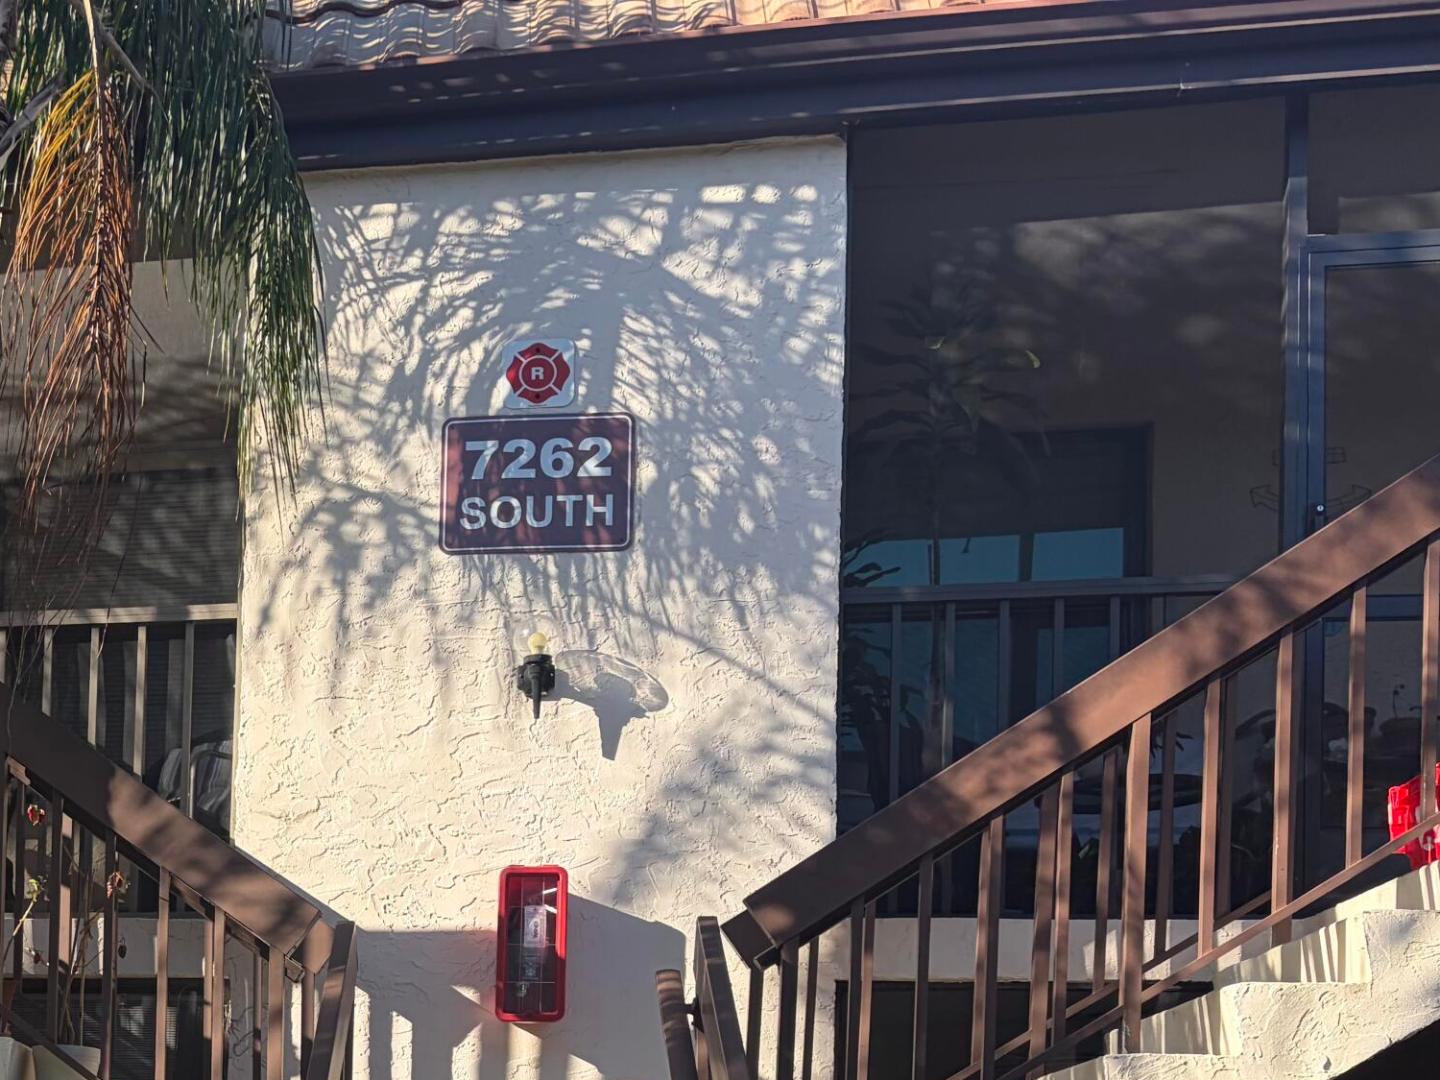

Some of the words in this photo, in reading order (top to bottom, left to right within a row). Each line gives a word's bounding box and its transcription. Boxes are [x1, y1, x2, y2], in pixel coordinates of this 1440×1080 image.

[530, 366, 545, 381] R
[464, 436, 613, 480] 7262
[459, 494, 614, 531] SOUTH
